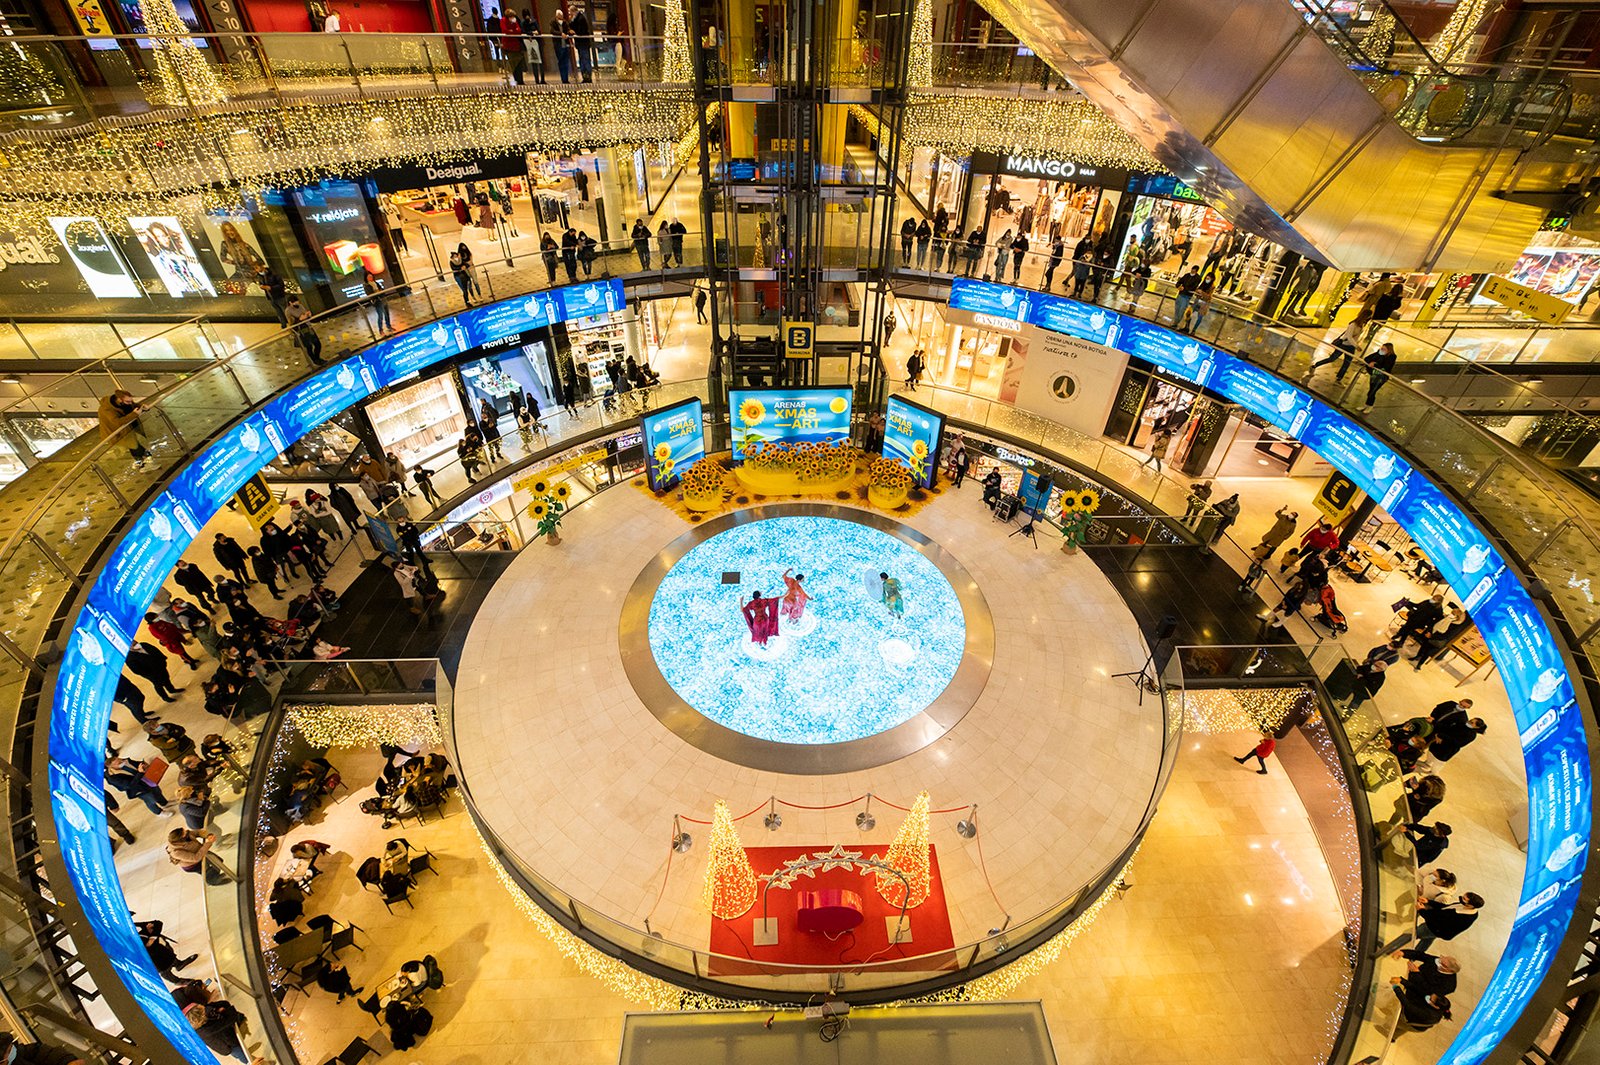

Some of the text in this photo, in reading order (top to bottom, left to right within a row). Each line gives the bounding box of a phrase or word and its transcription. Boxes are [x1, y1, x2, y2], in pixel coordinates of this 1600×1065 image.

[222, 1, 230, 13] 9
[452, 6, 460, 18] 3
[224, 17, 239, 30] 10
[456, 22, 462, 32] 4
[238, 50, 252, 63] 12
[1006, 155, 1076, 178] MANGO
[1173, 182, 1203, 200] bas
[975, 312, 1020, 331] PANDORA
[794, 330, 806, 346] B
[774, 408, 817, 419] XMAS
[670, 418, 694, 434] XMAS
[792, 419, 820, 429] ART
[889, 415, 912, 429] XMAS
[680, 424, 698, 438] ART
[897, 425, 914, 437] ART
[246, 482, 266, 510] A
[1330, 480, 1350, 504] C
